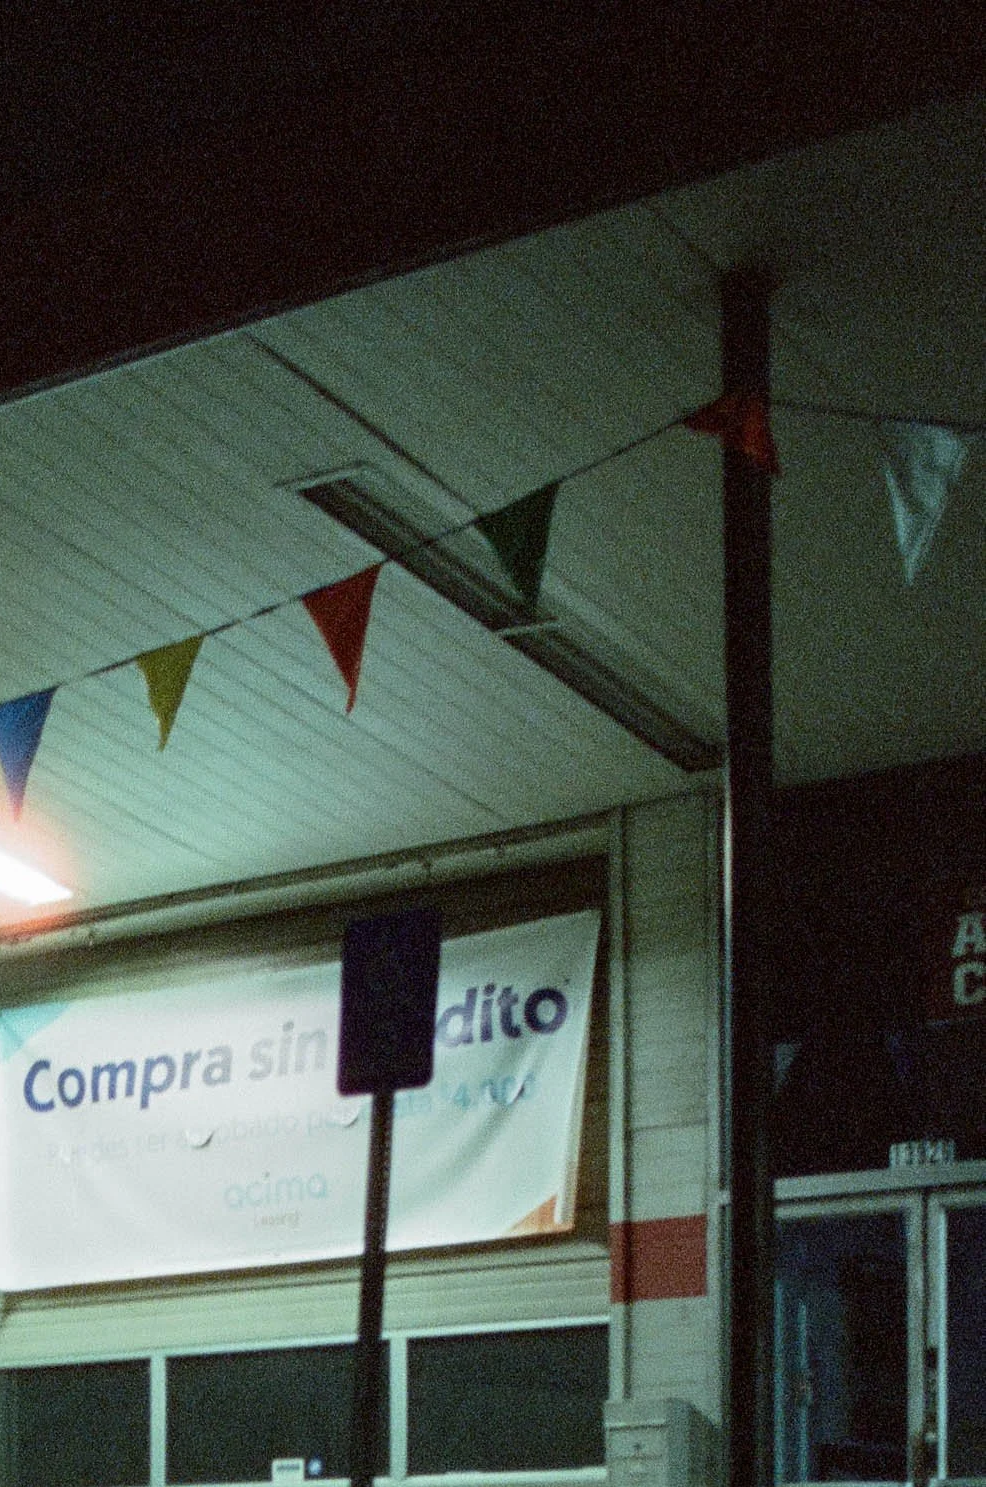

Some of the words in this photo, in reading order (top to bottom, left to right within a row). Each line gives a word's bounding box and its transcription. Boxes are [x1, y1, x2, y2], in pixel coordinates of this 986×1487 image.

[23, 1043, 233, 1113] Compra
[248, 1020, 329, 1081] sin
[435, 979, 568, 1048] dito
[222, 1171, 330, 1210] acima
